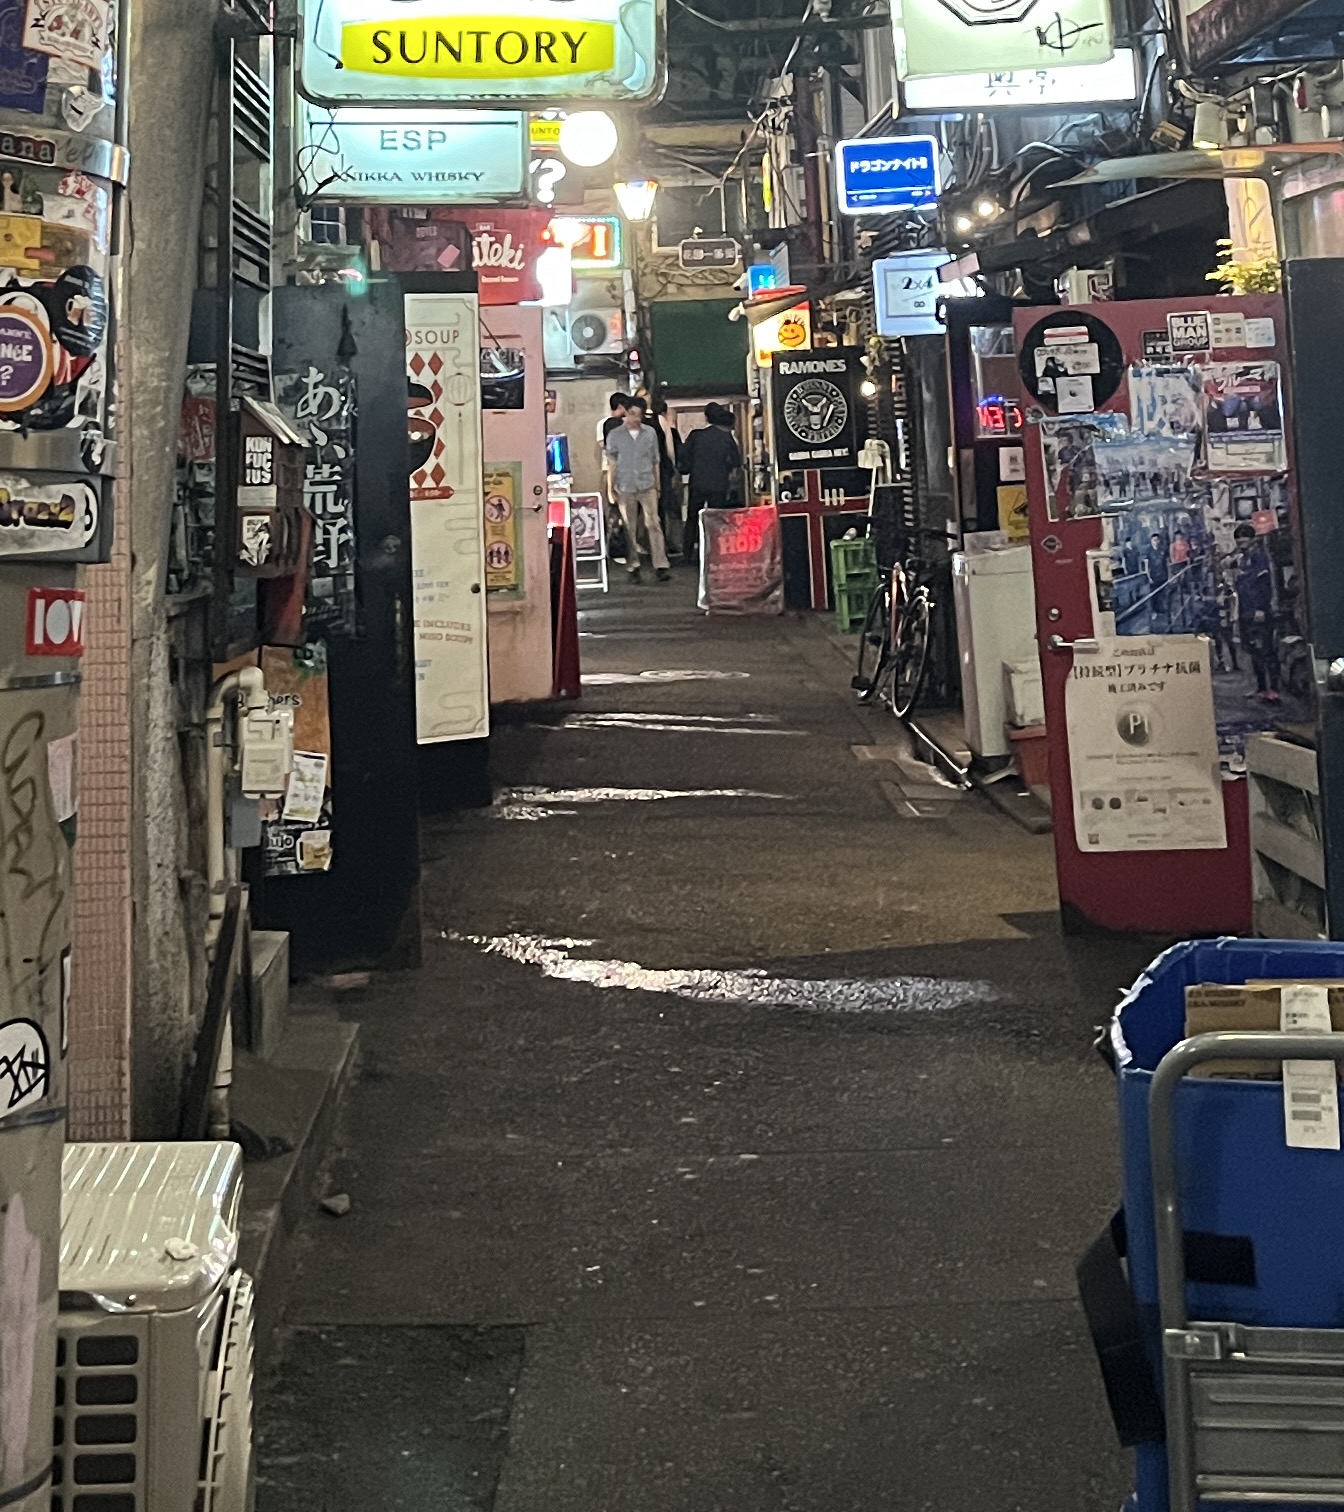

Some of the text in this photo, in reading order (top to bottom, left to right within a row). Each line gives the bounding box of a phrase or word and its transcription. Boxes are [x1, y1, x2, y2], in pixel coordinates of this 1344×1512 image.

[372, 30, 588, 65] SUNTORY
[380, 130, 447, 152] ESP
[412, 171, 484, 182] WHISKY
[415, 330, 460, 344] SOUP
[1173, 326, 1206, 338] MAN
[779, 359, 847, 375] RAMONES
[246, 437, 272, 452] KON
